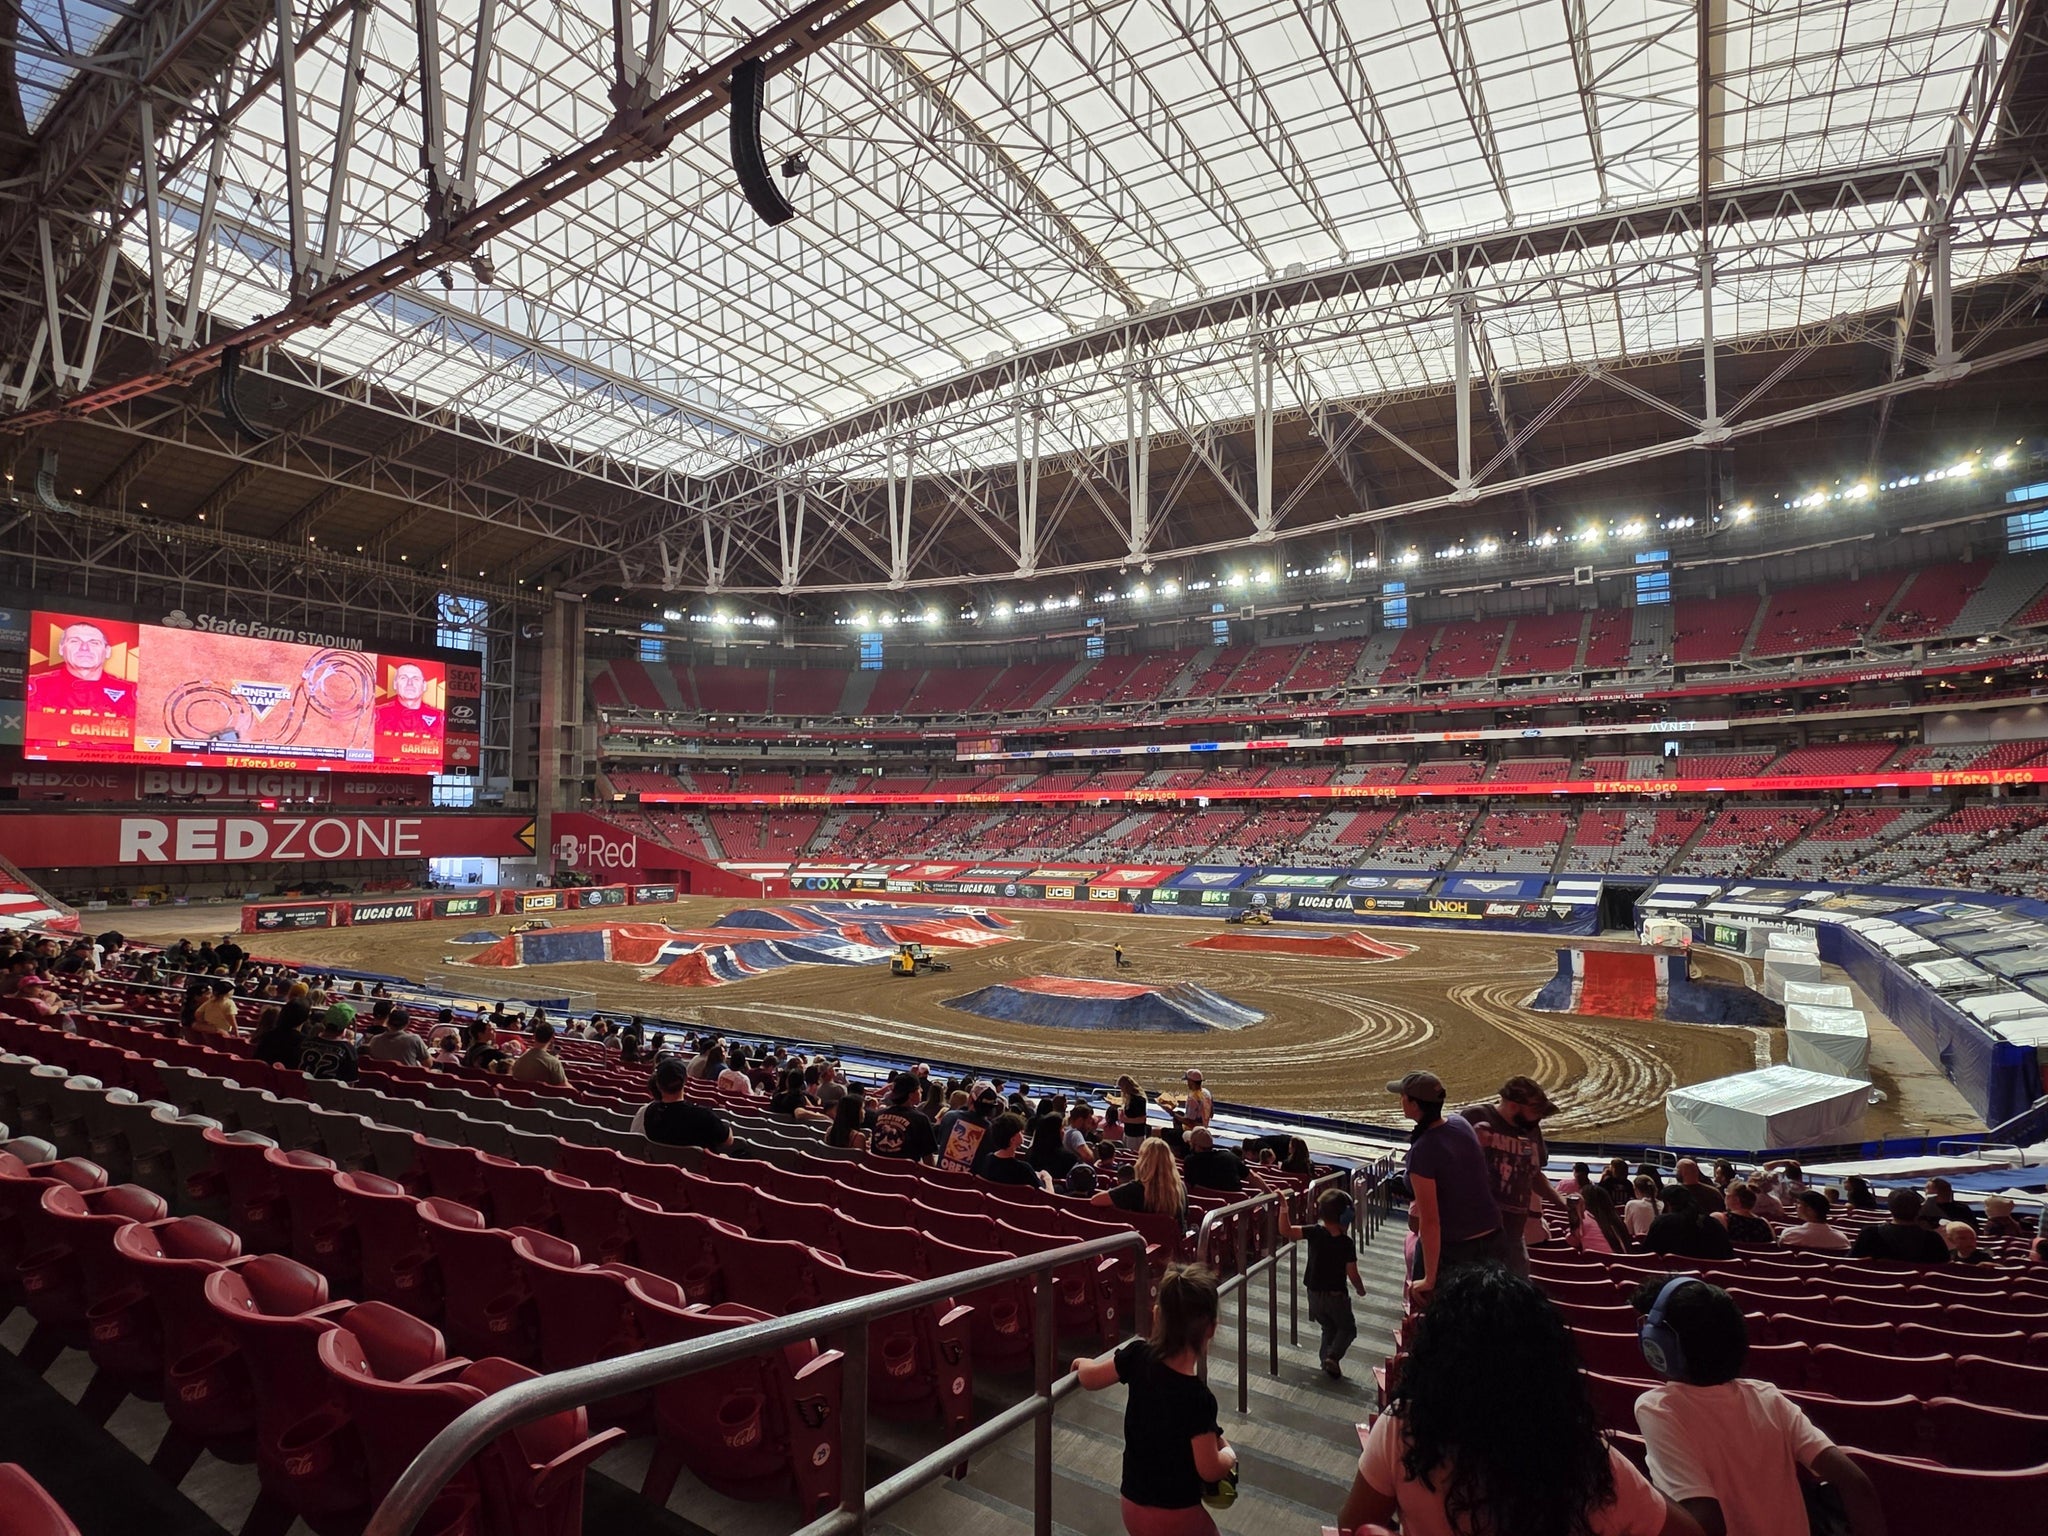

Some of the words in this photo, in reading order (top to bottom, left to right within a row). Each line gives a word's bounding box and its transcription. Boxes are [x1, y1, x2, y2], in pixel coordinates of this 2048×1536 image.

[297, 631, 363, 651] STADIUM
[2011, 656, 2026, 666] JIM
[449, 669, 477, 681] SEAT
[1860, 672, 1883, 682] KURT
[1885, 669, 1923, 679] WARNER
[230, 686, 291, 699] MONSTER
[449, 680, 478, 693] GEEK
[248, 696, 275, 706] JAM
[0, 715, 20, 730] X
[448, 717, 477, 725] HYUNDAI
[1650, 721, 1696, 733] AVNET
[71, 722, 129, 737] GARNER
[401, 743, 439, 755] GARNER
[76, 752, 115, 760] JAMEY
[117, 753, 162, 761] GARNER
[240, 757, 267, 769] Toro
[270, 759, 297, 770] Loco
[143, 770, 224, 796] BUD
[228, 772, 327, 798] LIGHT
[1750, 780, 1791, 788] JAMEY
[1793, 778, 1846, 787] GARNER
[1951, 772, 1990, 785] Toro
[1992, 771, 2034, 785] Loco
[1343, 788, 1368, 797] Toro
[1370, 787, 1397, 796] Loco
[1609, 783, 1642, 793] Toro
[1644, 782, 1679, 792] Loco
[118, 818, 422, 862] REDZONE
[588, 834, 637, 868] Red
[805, 877, 840, 891] COX
[959, 884, 983, 894] LUCAS
[983, 885, 996, 895] OIL
[1047, 888, 1073, 897] JCB
[1091, 889, 1118, 899] JCB
[1152, 889, 1179, 901] BKT
[1201, 890, 1231, 903] BKT
[446, 899, 479, 911] BKT
[526, 897, 554, 908] JCB
[1297, 895, 1335, 909] LUCAS
[1428, 900, 1468, 913] UNOH
[353, 907, 394, 921] LUCAS
[394, 904, 414, 918] OIL
[1714, 925, 1738, 944] BKT
[302, 1048, 340, 1076] 82
[941, 1159, 971, 1173] OBEY
